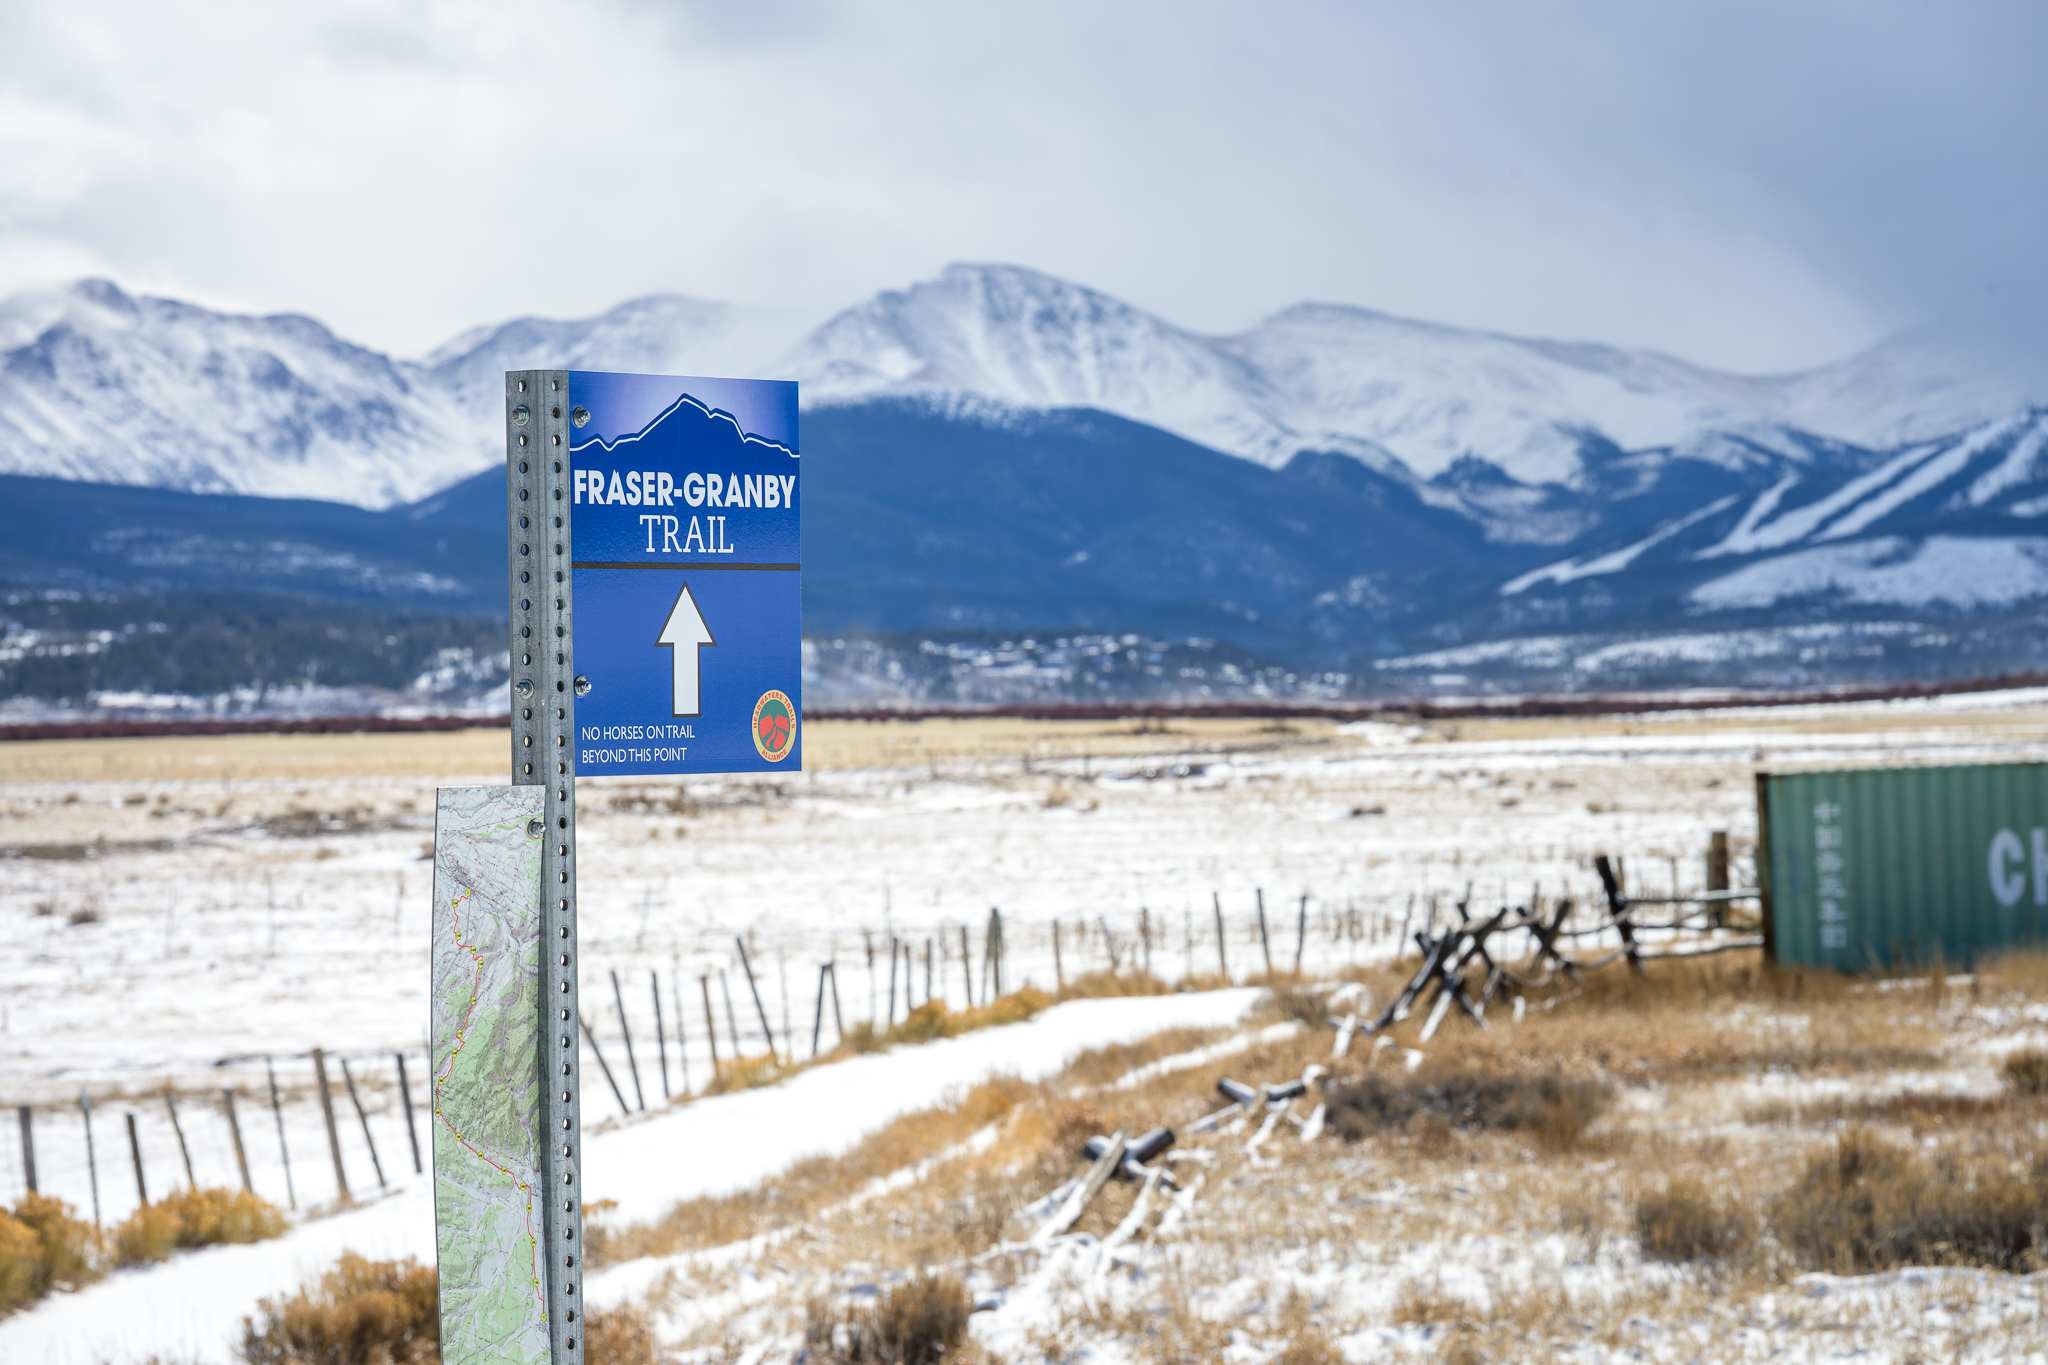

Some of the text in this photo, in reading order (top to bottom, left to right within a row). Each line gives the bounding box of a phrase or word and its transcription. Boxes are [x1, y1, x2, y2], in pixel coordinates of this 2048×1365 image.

[574, 469, 796, 509] FRASER-GRANBY
[639, 514, 734, 553] TRAIL
[582, 725, 696, 741] NO HORSES ON TRAIL
[582, 747, 688, 764] BEYOND THIS POINT
